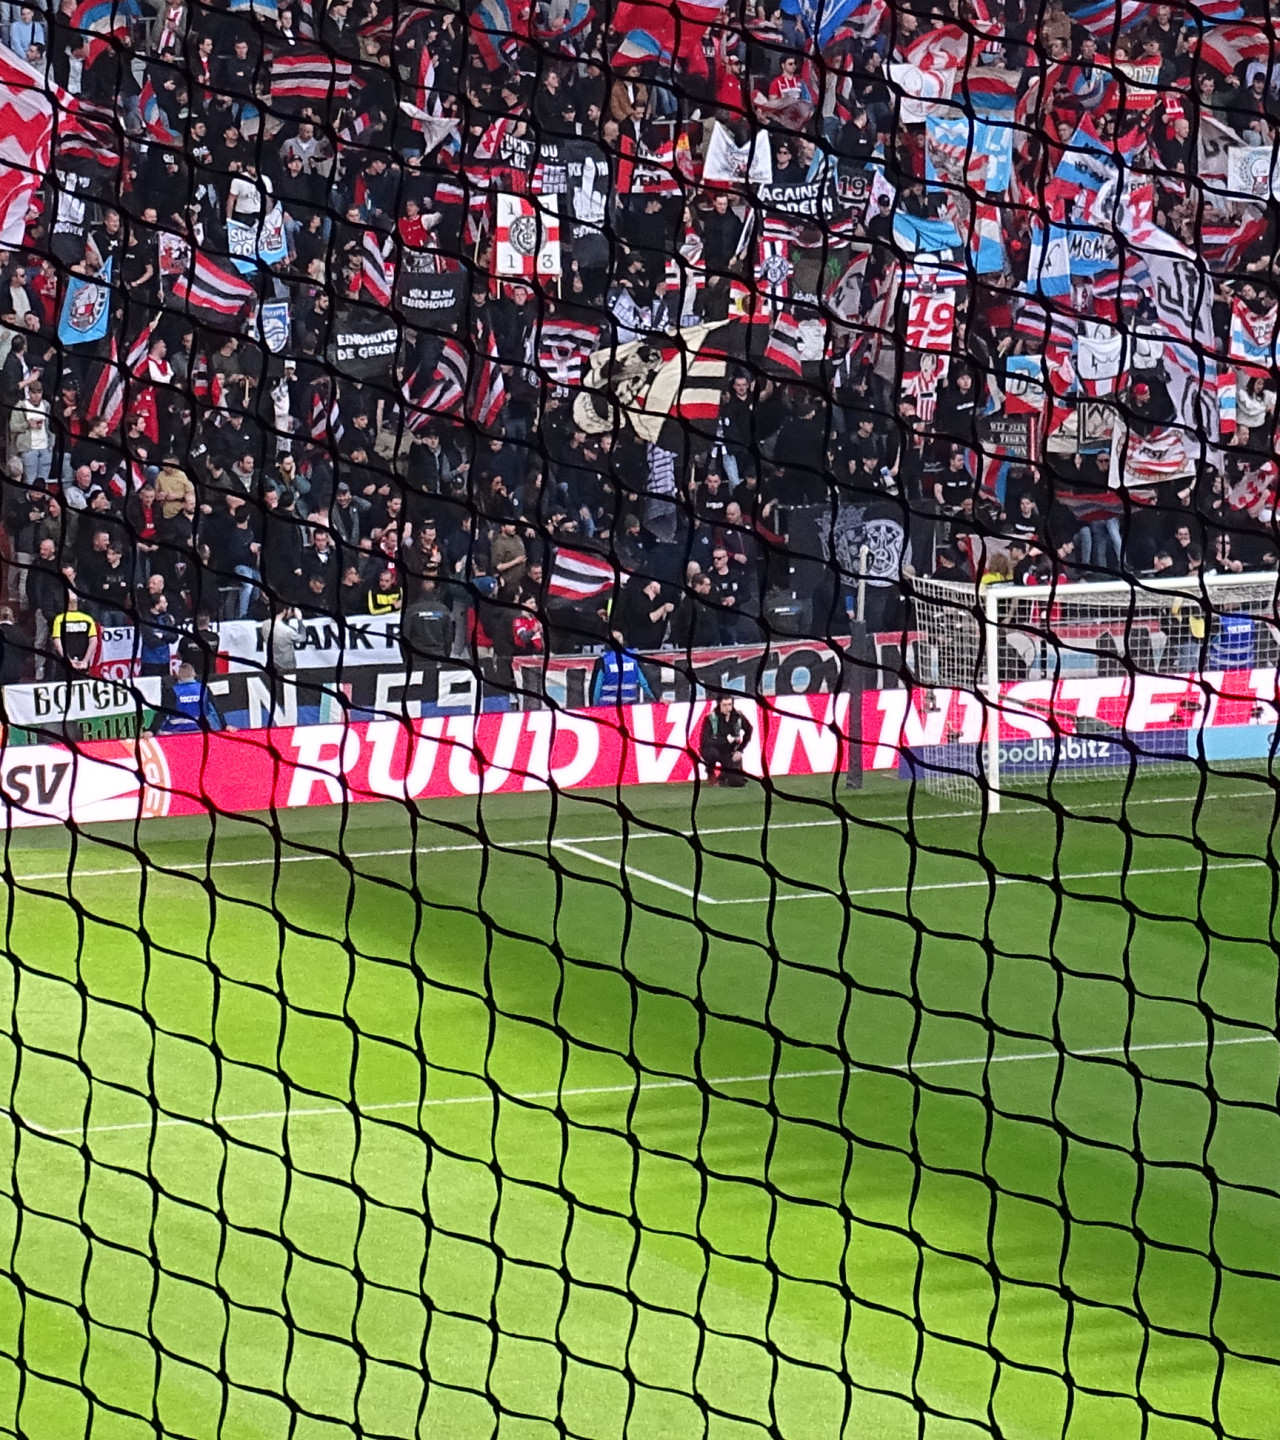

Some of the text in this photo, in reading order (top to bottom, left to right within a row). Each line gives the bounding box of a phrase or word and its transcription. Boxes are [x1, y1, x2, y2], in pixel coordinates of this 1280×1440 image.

[762, 182, 831, 201] AGAINST
[542, 254, 555, 270] 3
[401, 296, 457, 310] EINDHOVEN
[907, 295, 956, 338] 19
[336, 329, 399, 347] EINDHOVE
[336, 348, 355, 361] DE
[288, 707, 601, 807] RUUD
[632, 691, 851, 784] VAN
